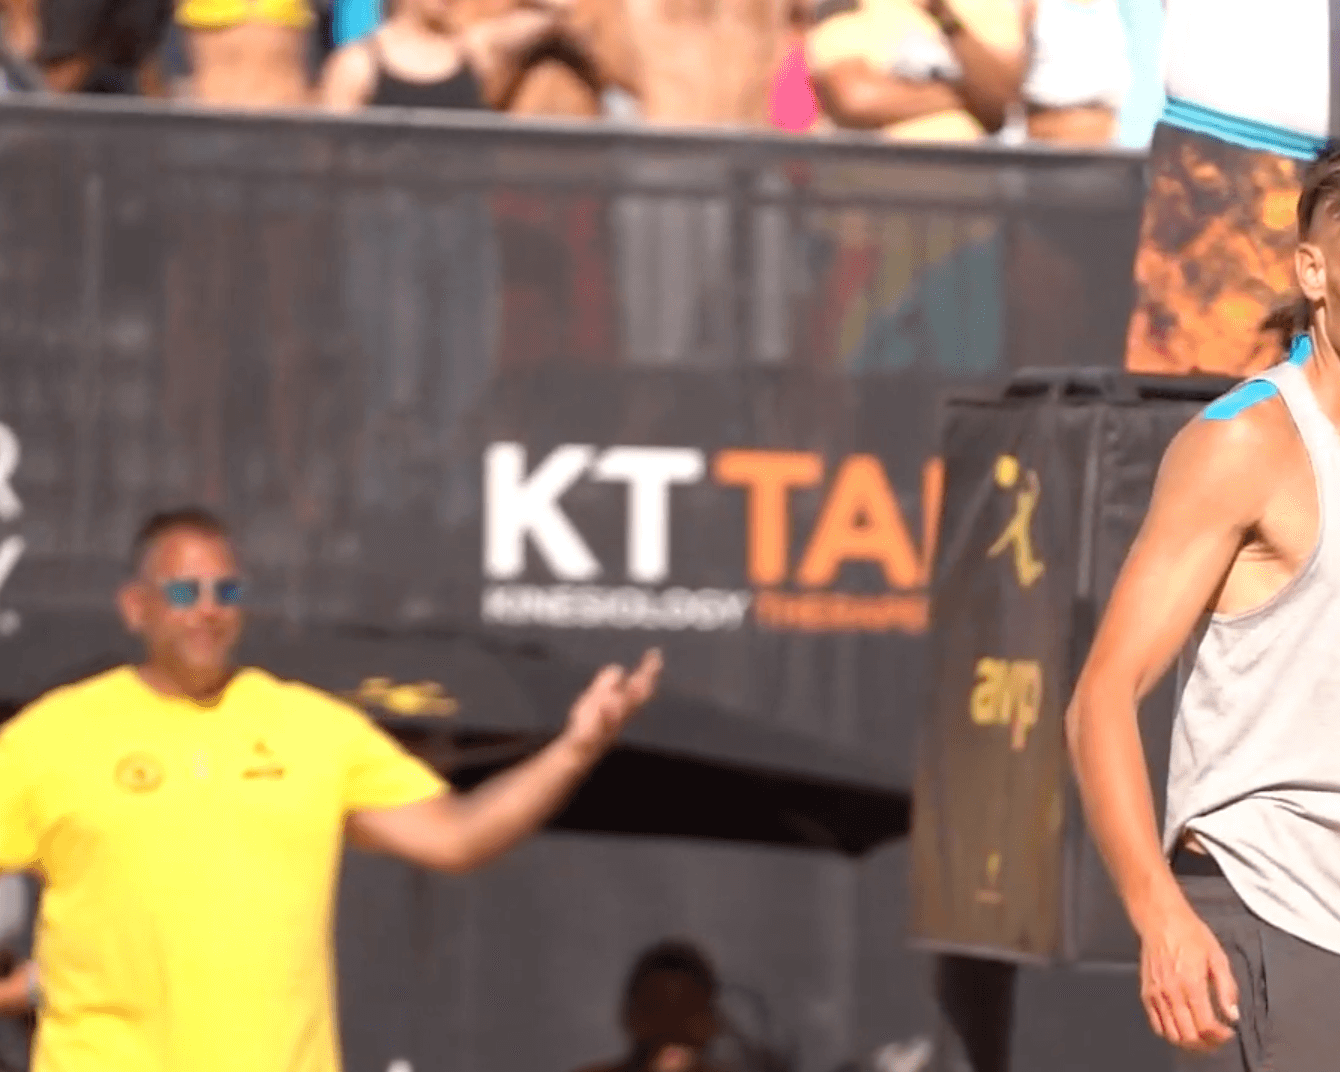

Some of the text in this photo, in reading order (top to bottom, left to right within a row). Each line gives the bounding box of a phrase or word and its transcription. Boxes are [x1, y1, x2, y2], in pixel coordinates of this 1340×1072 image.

[483, 442, 945, 588] KT TA
[970, 656, 1043, 751] avp
